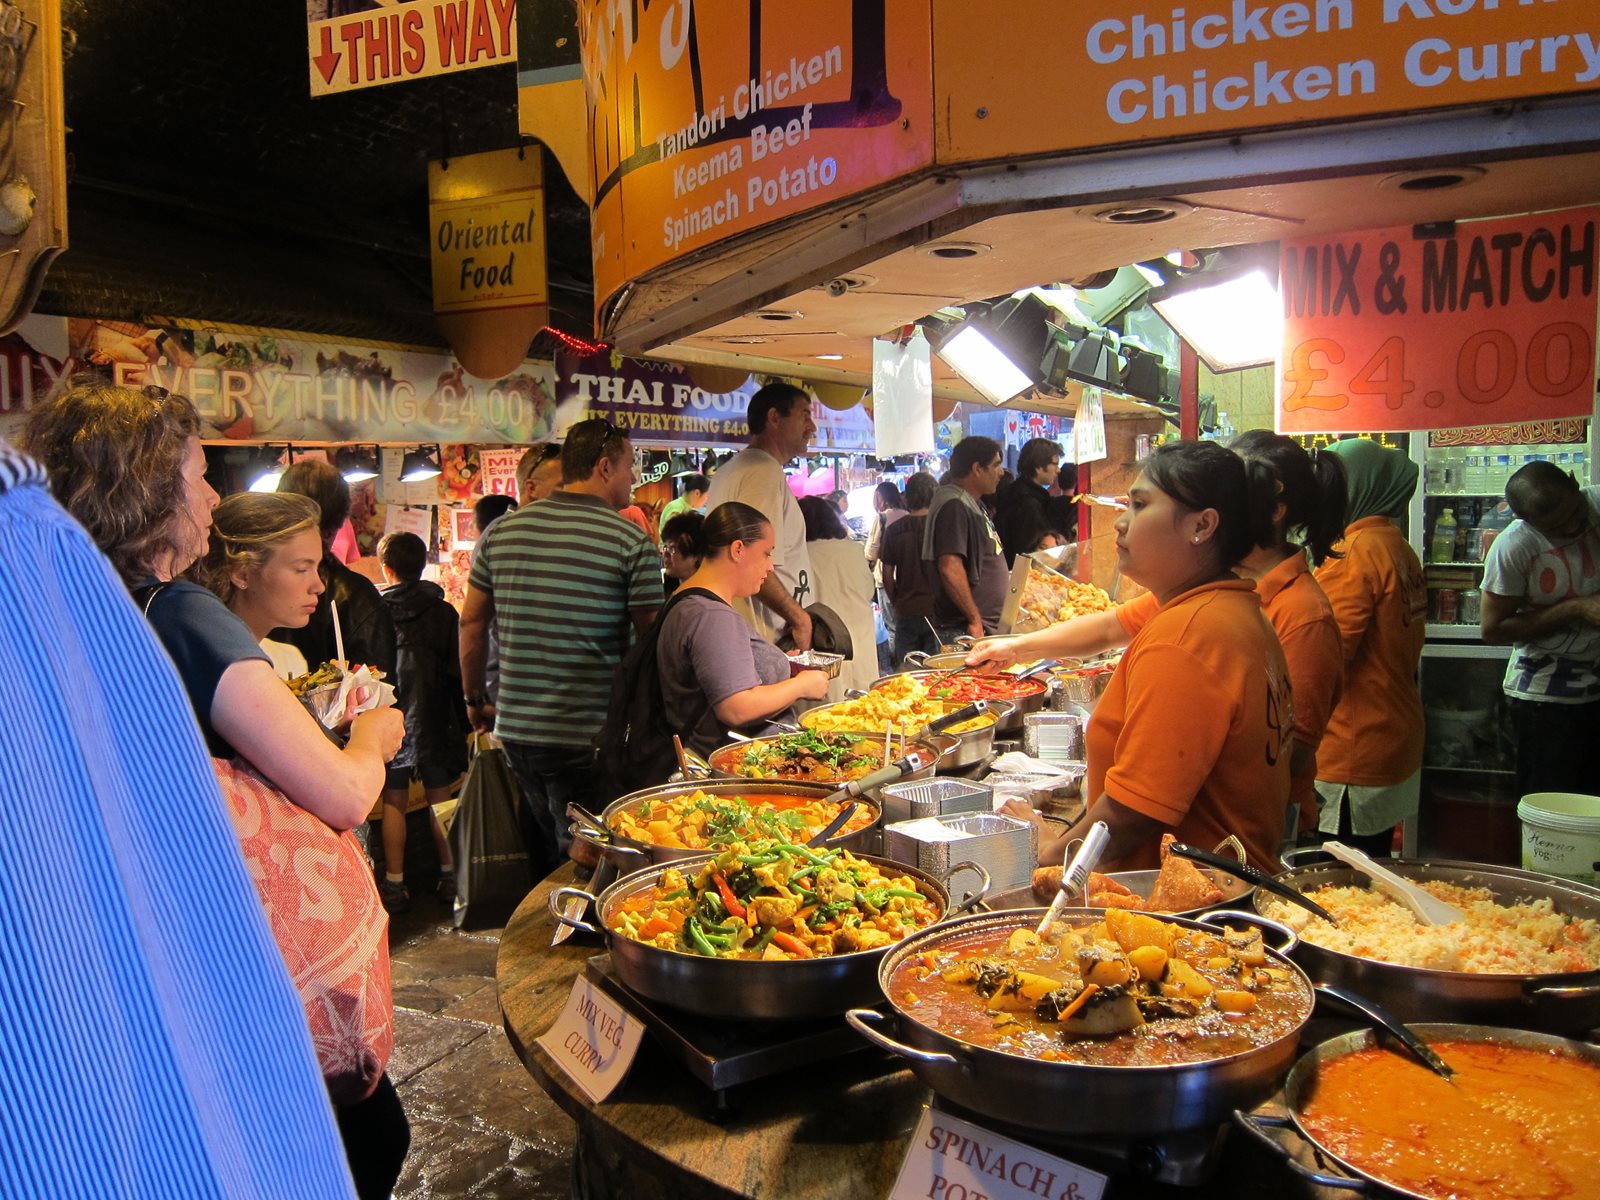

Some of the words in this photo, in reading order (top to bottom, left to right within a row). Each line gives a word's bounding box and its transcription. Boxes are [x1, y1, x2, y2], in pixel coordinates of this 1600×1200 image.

[341, 10, 425, 84] THIS
[434, 0, 516, 67] WAY
[1085, 0, 1354, 65] Chicken
[656, 96, 725, 162] Tandori
[733, 45, 842, 121] Chicken
[1106, 58, 1376, 125] Chicken
[1404, 33, 1600, 88] Curry
[673, 145, 743, 199] Keema
[751, 103, 813, 162] Beef
[438, 208, 535, 252] Oriental
[663, 188, 739, 250] Spinach
[748, 155, 837, 212] Potato
[460, 252, 514, 291] Food
[1283, 241, 1362, 319] MIX
[1374, 241, 1407, 316] &
[1422, 220, 1596, 314] MATCH
[0, 354, 75, 412] IX
[113, 361, 418, 425] EVERYTHING
[438, 384, 524, 427] £4.00
[570, 373, 664, 407] THAI
[672, 382, 749, 414] FOOD
[1283, 321, 1592, 413] £4.00
[615, 410, 719, 434] EVERYTHING
[564, 1032, 607, 1074] CURRY
[575, 994, 601, 1027] MIX
[600, 1013, 624, 1050] VEG.
[925, 1126, 1057, 1199] SPINACH
